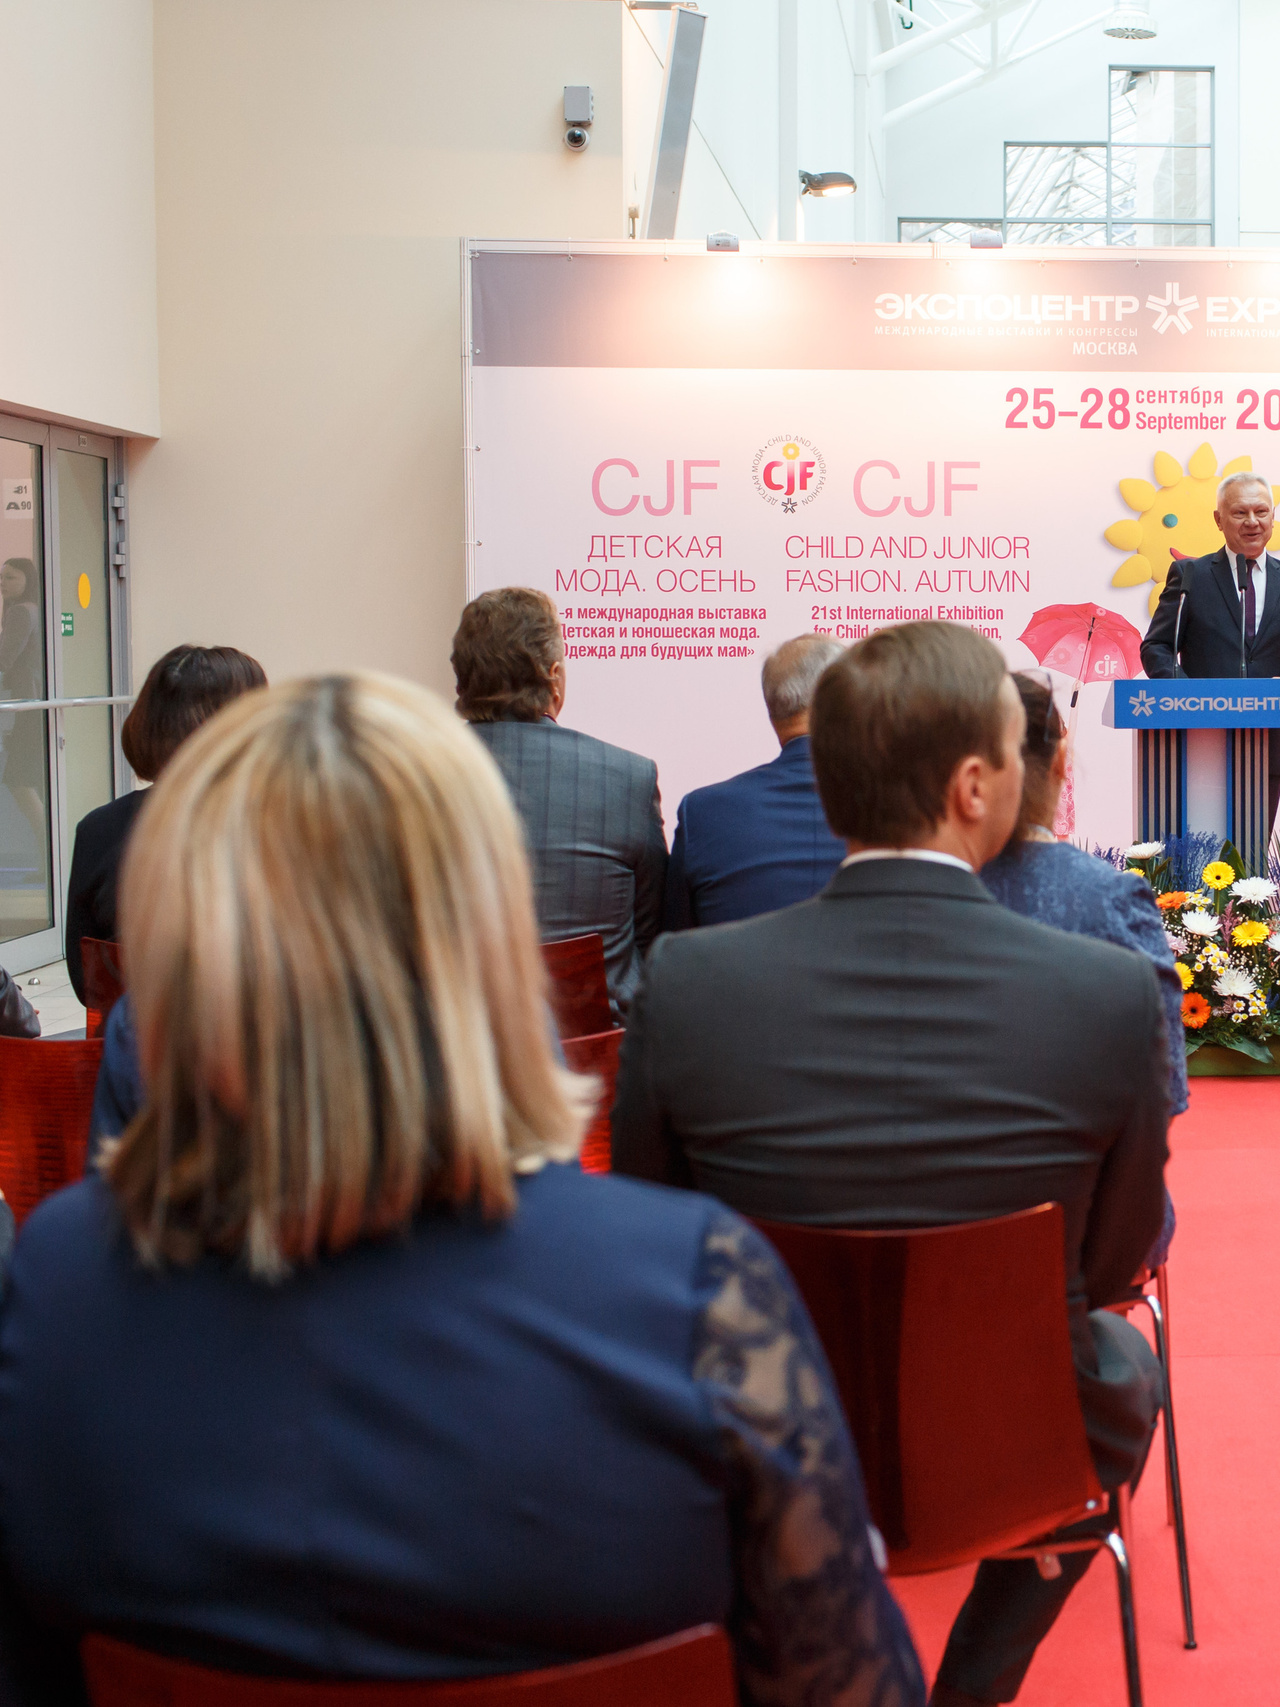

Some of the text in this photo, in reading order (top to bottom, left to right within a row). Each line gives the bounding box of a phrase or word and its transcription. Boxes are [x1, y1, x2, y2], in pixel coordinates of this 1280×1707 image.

[874, 293, 1139, 324] ЭКСПОЦЕНТР
[874, 325, 1138, 337] МЕЖДУНАРОДНЫЕ ВЫСТАВКИ И КОНГРЕССЫ
[1072, 341, 1138, 355] МОСКВА
[1136, 387, 1223, 408] сентября
[1136, 411, 1226, 433] September
[591, 458, 720, 516] CJF
[853, 460, 980, 517] CJF
[587, 535, 722, 562] ДЕТСКАЯ
[785, 535, 1030, 559] CHILD AND JUNIOR
[555, 569, 756, 596] МОДА. ОСЕНЬ
[786, 570, 1030, 593] FASHION. AUTUMN
[559, 608, 766, 622] -я международная выставка
[811, 606, 1004, 620] 21st International Exhibition
[561, 624, 760, 640] етская и юношеская мода.
[836, 625, 868, 639] Child
[620, 646, 646, 659] для
[651, 643, 713, 660] будущих
[718, 646, 755, 657] мам»
